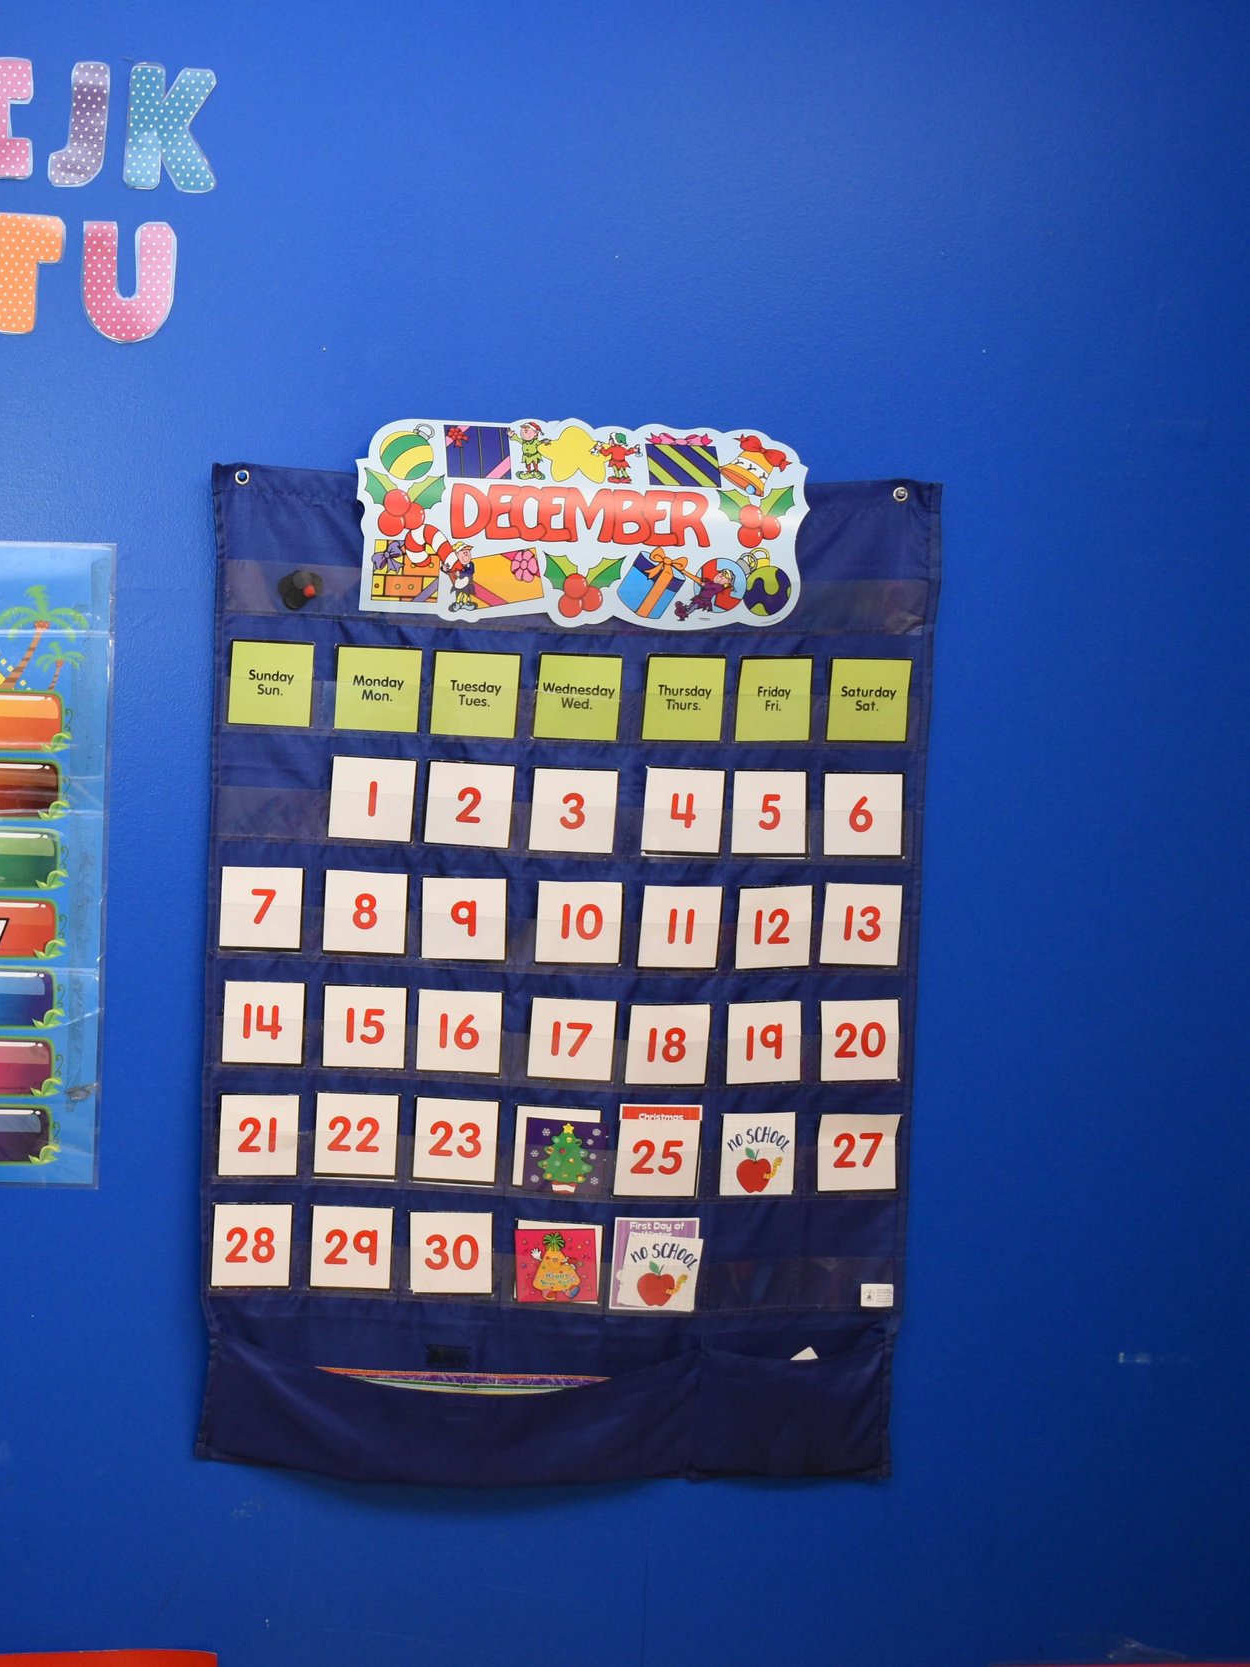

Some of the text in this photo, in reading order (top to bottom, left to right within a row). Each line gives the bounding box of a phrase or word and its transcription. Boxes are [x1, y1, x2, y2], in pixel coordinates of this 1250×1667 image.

[49, 62, 109, 187] J
[123, 63, 216, 192] K
[82, 222, 176, 342] U
[449, 482, 710, 548] DECEMBER
[248, 669, 295, 685] Sunday
[257, 683, 283, 696] Sun.
[352, 674, 405, 690] Monday
[361, 689, 393, 702] Mon.
[450, 679, 502, 696] Tuesday
[542, 681, 616, 699] Wednesday
[658, 684, 712, 700] Thursday
[757, 685, 792, 700] Friday
[840, 685, 897, 701] Saturday
[458, 694, 490, 707] Tues.
[561, 697, 592, 710] Wed.
[665, 698, 701, 711] Thurs.
[765, 699, 782, 712] Fri.
[855, 699, 879, 712] Sat.
[368, 781, 378, 817] 1
[455, 786, 482, 824] 2
[560, 792, 585, 830] 3
[670, 793, 696, 829] 4
[759, 793, 781, 830] 5
[849, 796, 873, 833] 6
[251, 888, 277, 925] 7
[352, 893, 378, 930] 8
[450, 900, 477, 937] 9
[561, 903, 603, 940] 10
[844, 905, 881, 942] 13
[667, 908, 695, 945] 11
[754, 908, 790, 945] 12
[243, 1003, 283, 1040] 14
[346, 1007, 385, 1045] 15
[439, 1013, 480, 1050] 16
[551, 1021, 593, 1057] 17
[834, 1021, 887, 1059] 20
[647, 1027, 686, 1063] 18
[745, 1023, 783, 1062] 19
[237, 1116, 277, 1153] 21
[327, 1115, 380, 1153] 22
[429, 1120, 482, 1159] 23
[746, 1126, 791, 1153] SCHOOL
[833, 1132, 884, 1169] 27
[630, 1139, 684, 1175] 25
[225, 1226, 275, 1264] 28
[630, 1221, 652, 1230] First
[653, 1221, 672, 1233] Day
[674, 1221, 685, 1230] of
[324, 1228, 378, 1266] 29
[424, 1233, 479, 1271] 30
[651, 1242, 699, 1271] SCHOOL
